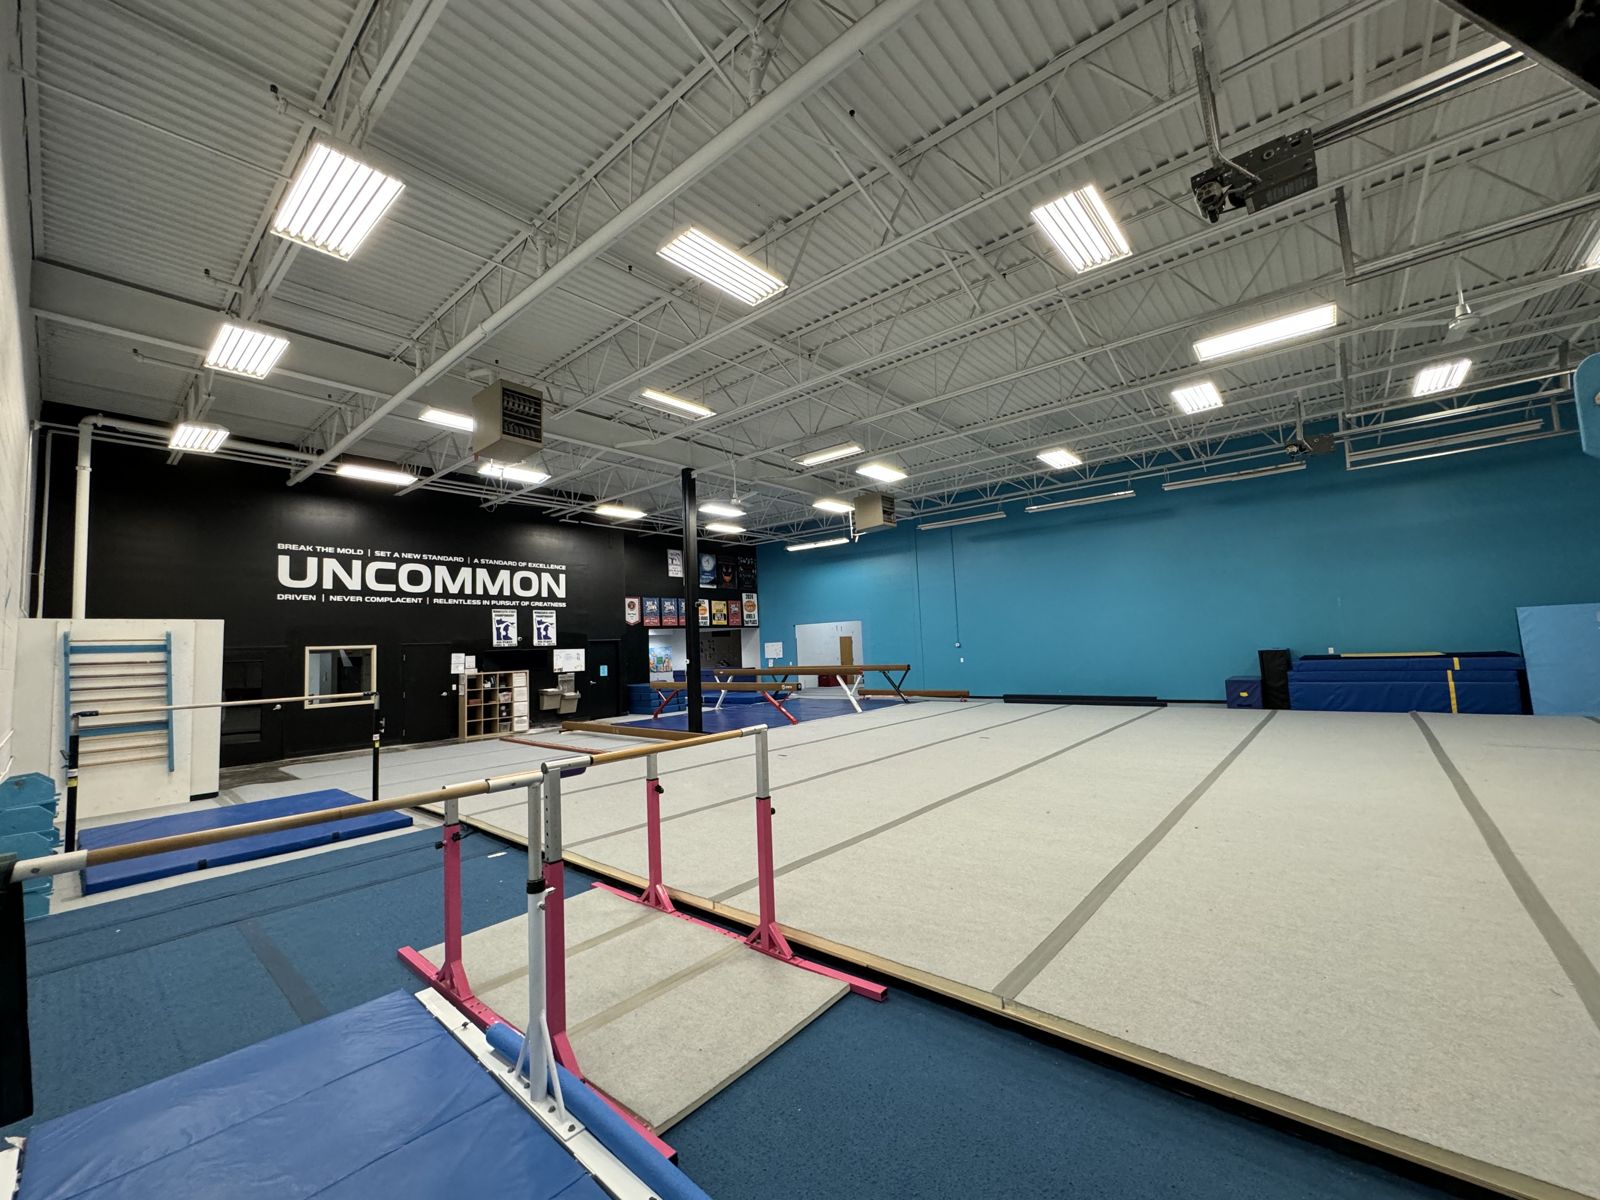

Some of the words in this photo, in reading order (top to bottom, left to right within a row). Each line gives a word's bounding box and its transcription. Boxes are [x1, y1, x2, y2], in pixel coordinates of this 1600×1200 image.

[277, 542, 314, 552] BREAK
[315, 545, 335, 554] THE
[336, 547, 364, 556] MOLD
[374, 550, 392, 558] SET
[401, 552, 422, 560] NEW
[422, 554, 465, 563] STANDARD
[480, 559, 518, 567] STANDARD
[528, 563, 567, 571] EXCELLENCE
[277, 554, 567, 599] UNCOMMON
[277, 594, 317, 602] DRIVEN
[329, 595, 363, 603] NEVER
[433, 598, 482, 606] RELENTLESS
